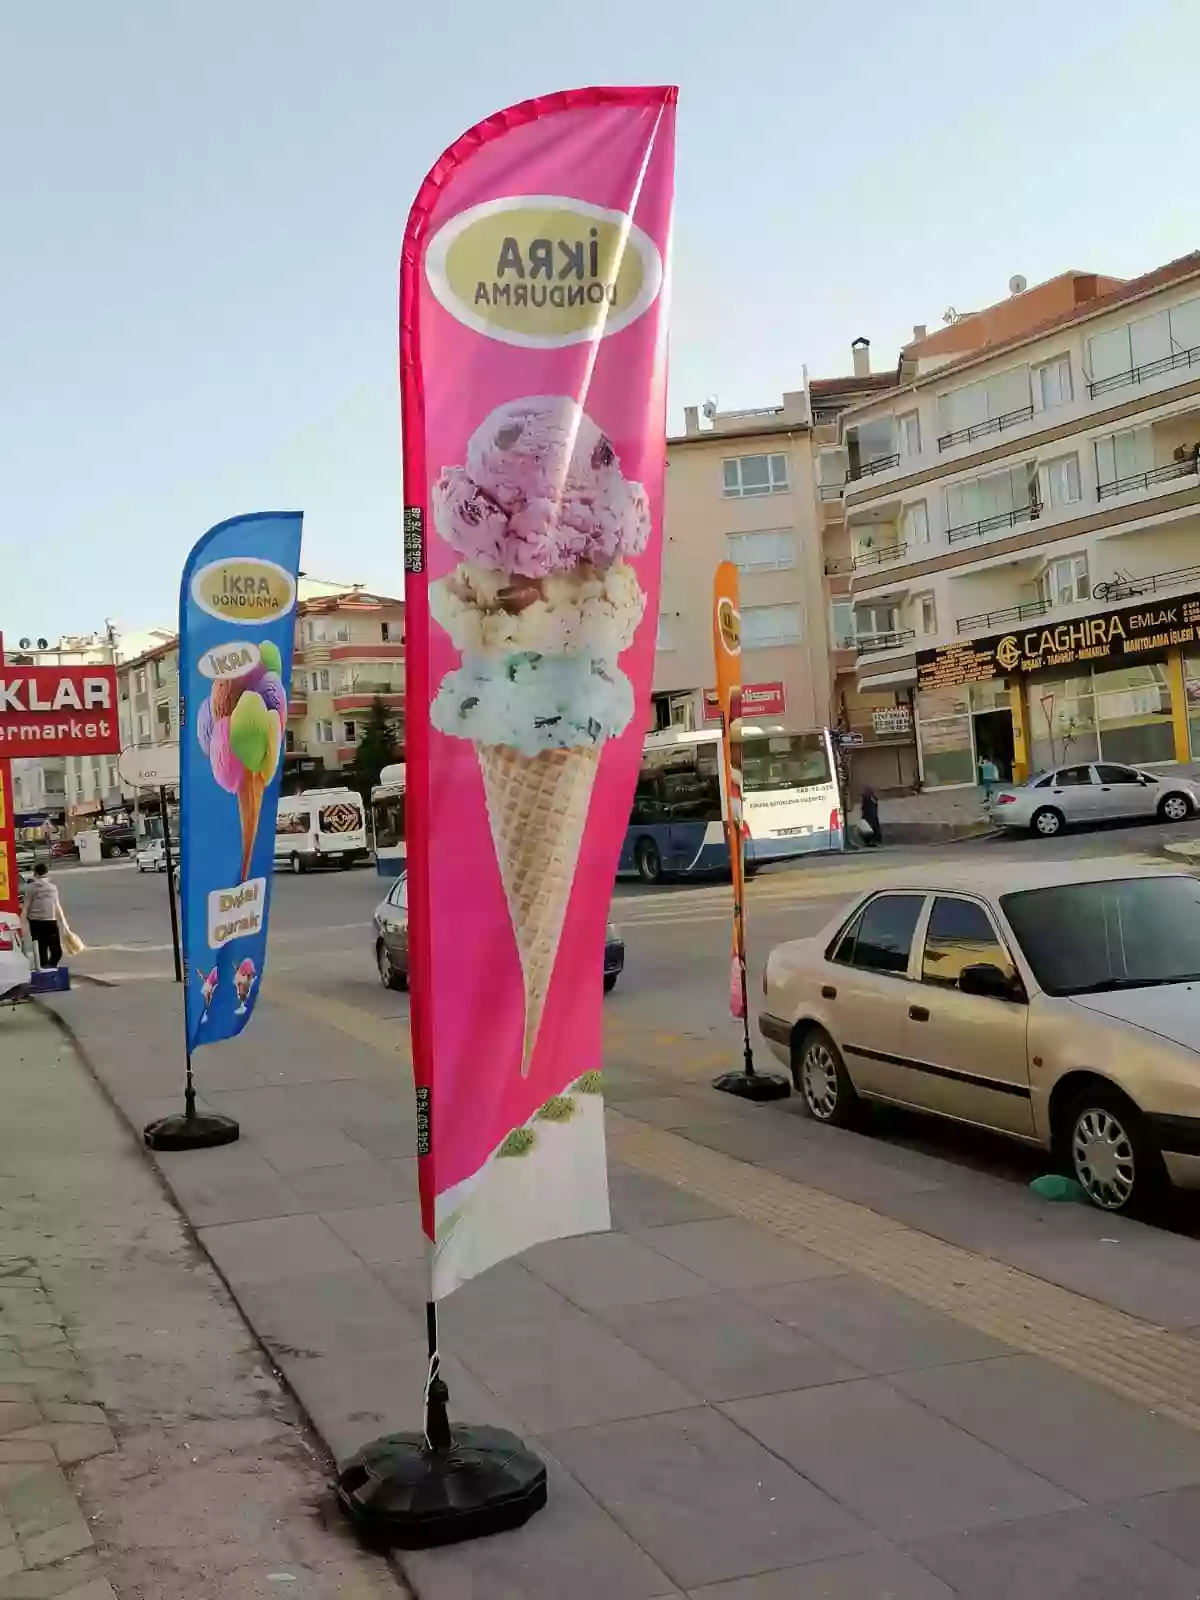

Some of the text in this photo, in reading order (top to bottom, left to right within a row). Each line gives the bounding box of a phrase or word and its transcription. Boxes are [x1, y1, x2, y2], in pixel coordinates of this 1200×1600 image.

[223, 569, 270, 595] İKRA
[1129, 608, 1178, 630] EMLAK
[0, 677, 112, 712] KLAR
